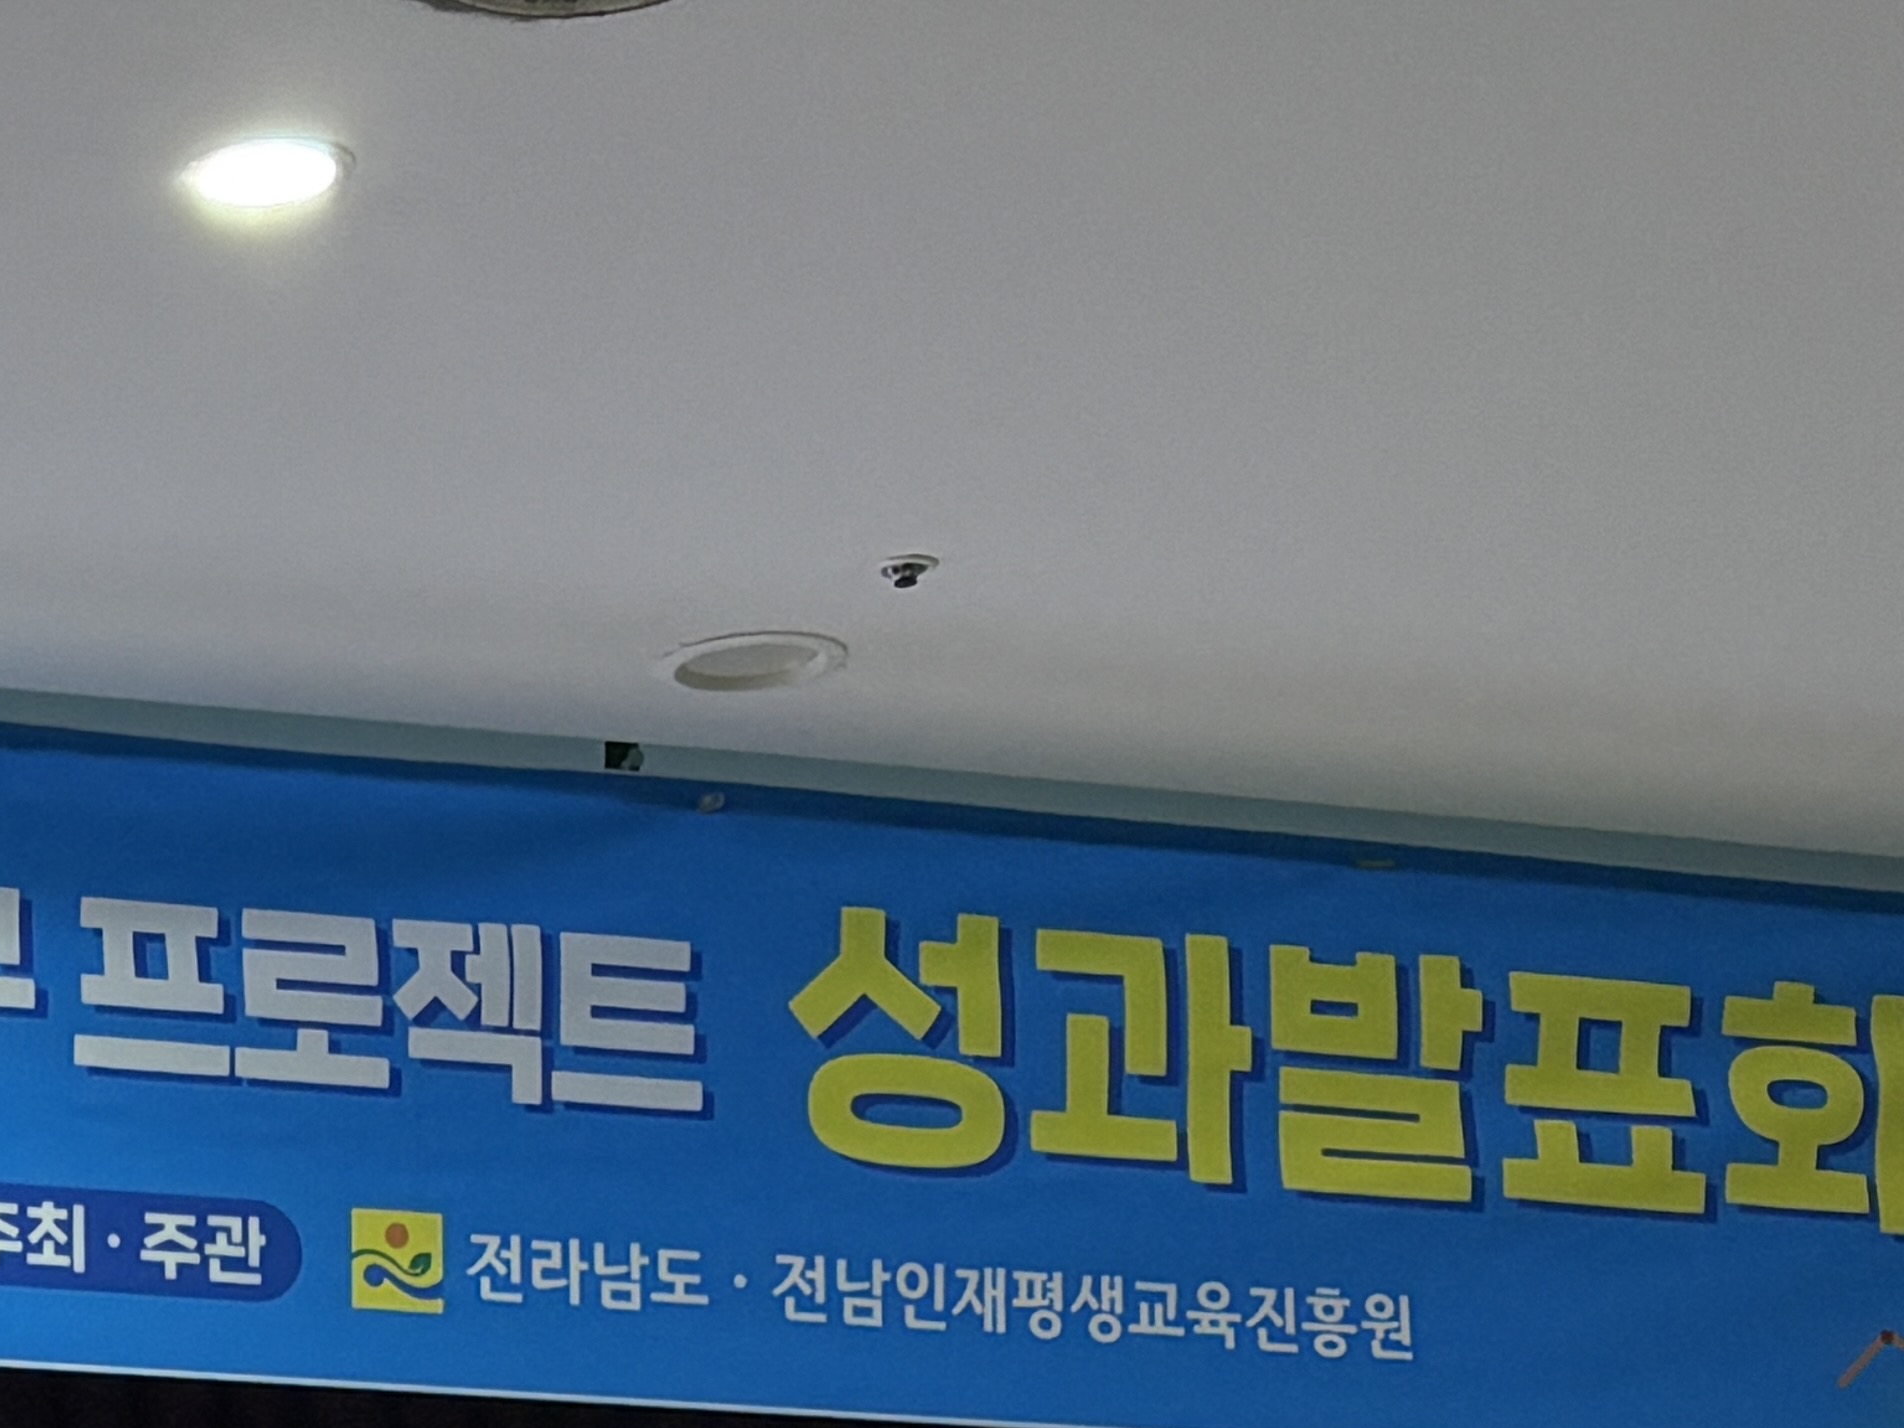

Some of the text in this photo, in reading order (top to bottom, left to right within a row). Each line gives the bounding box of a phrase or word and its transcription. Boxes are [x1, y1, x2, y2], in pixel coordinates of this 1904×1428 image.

[74, 897, 702, 1111] 프로젝트
[789, 907, 1904, 1234] 성과발표회
[467, 1234, 709, 1310] 전라남도
[773, 1255, 1413, 1360] 전남인재평생교육진흥원
